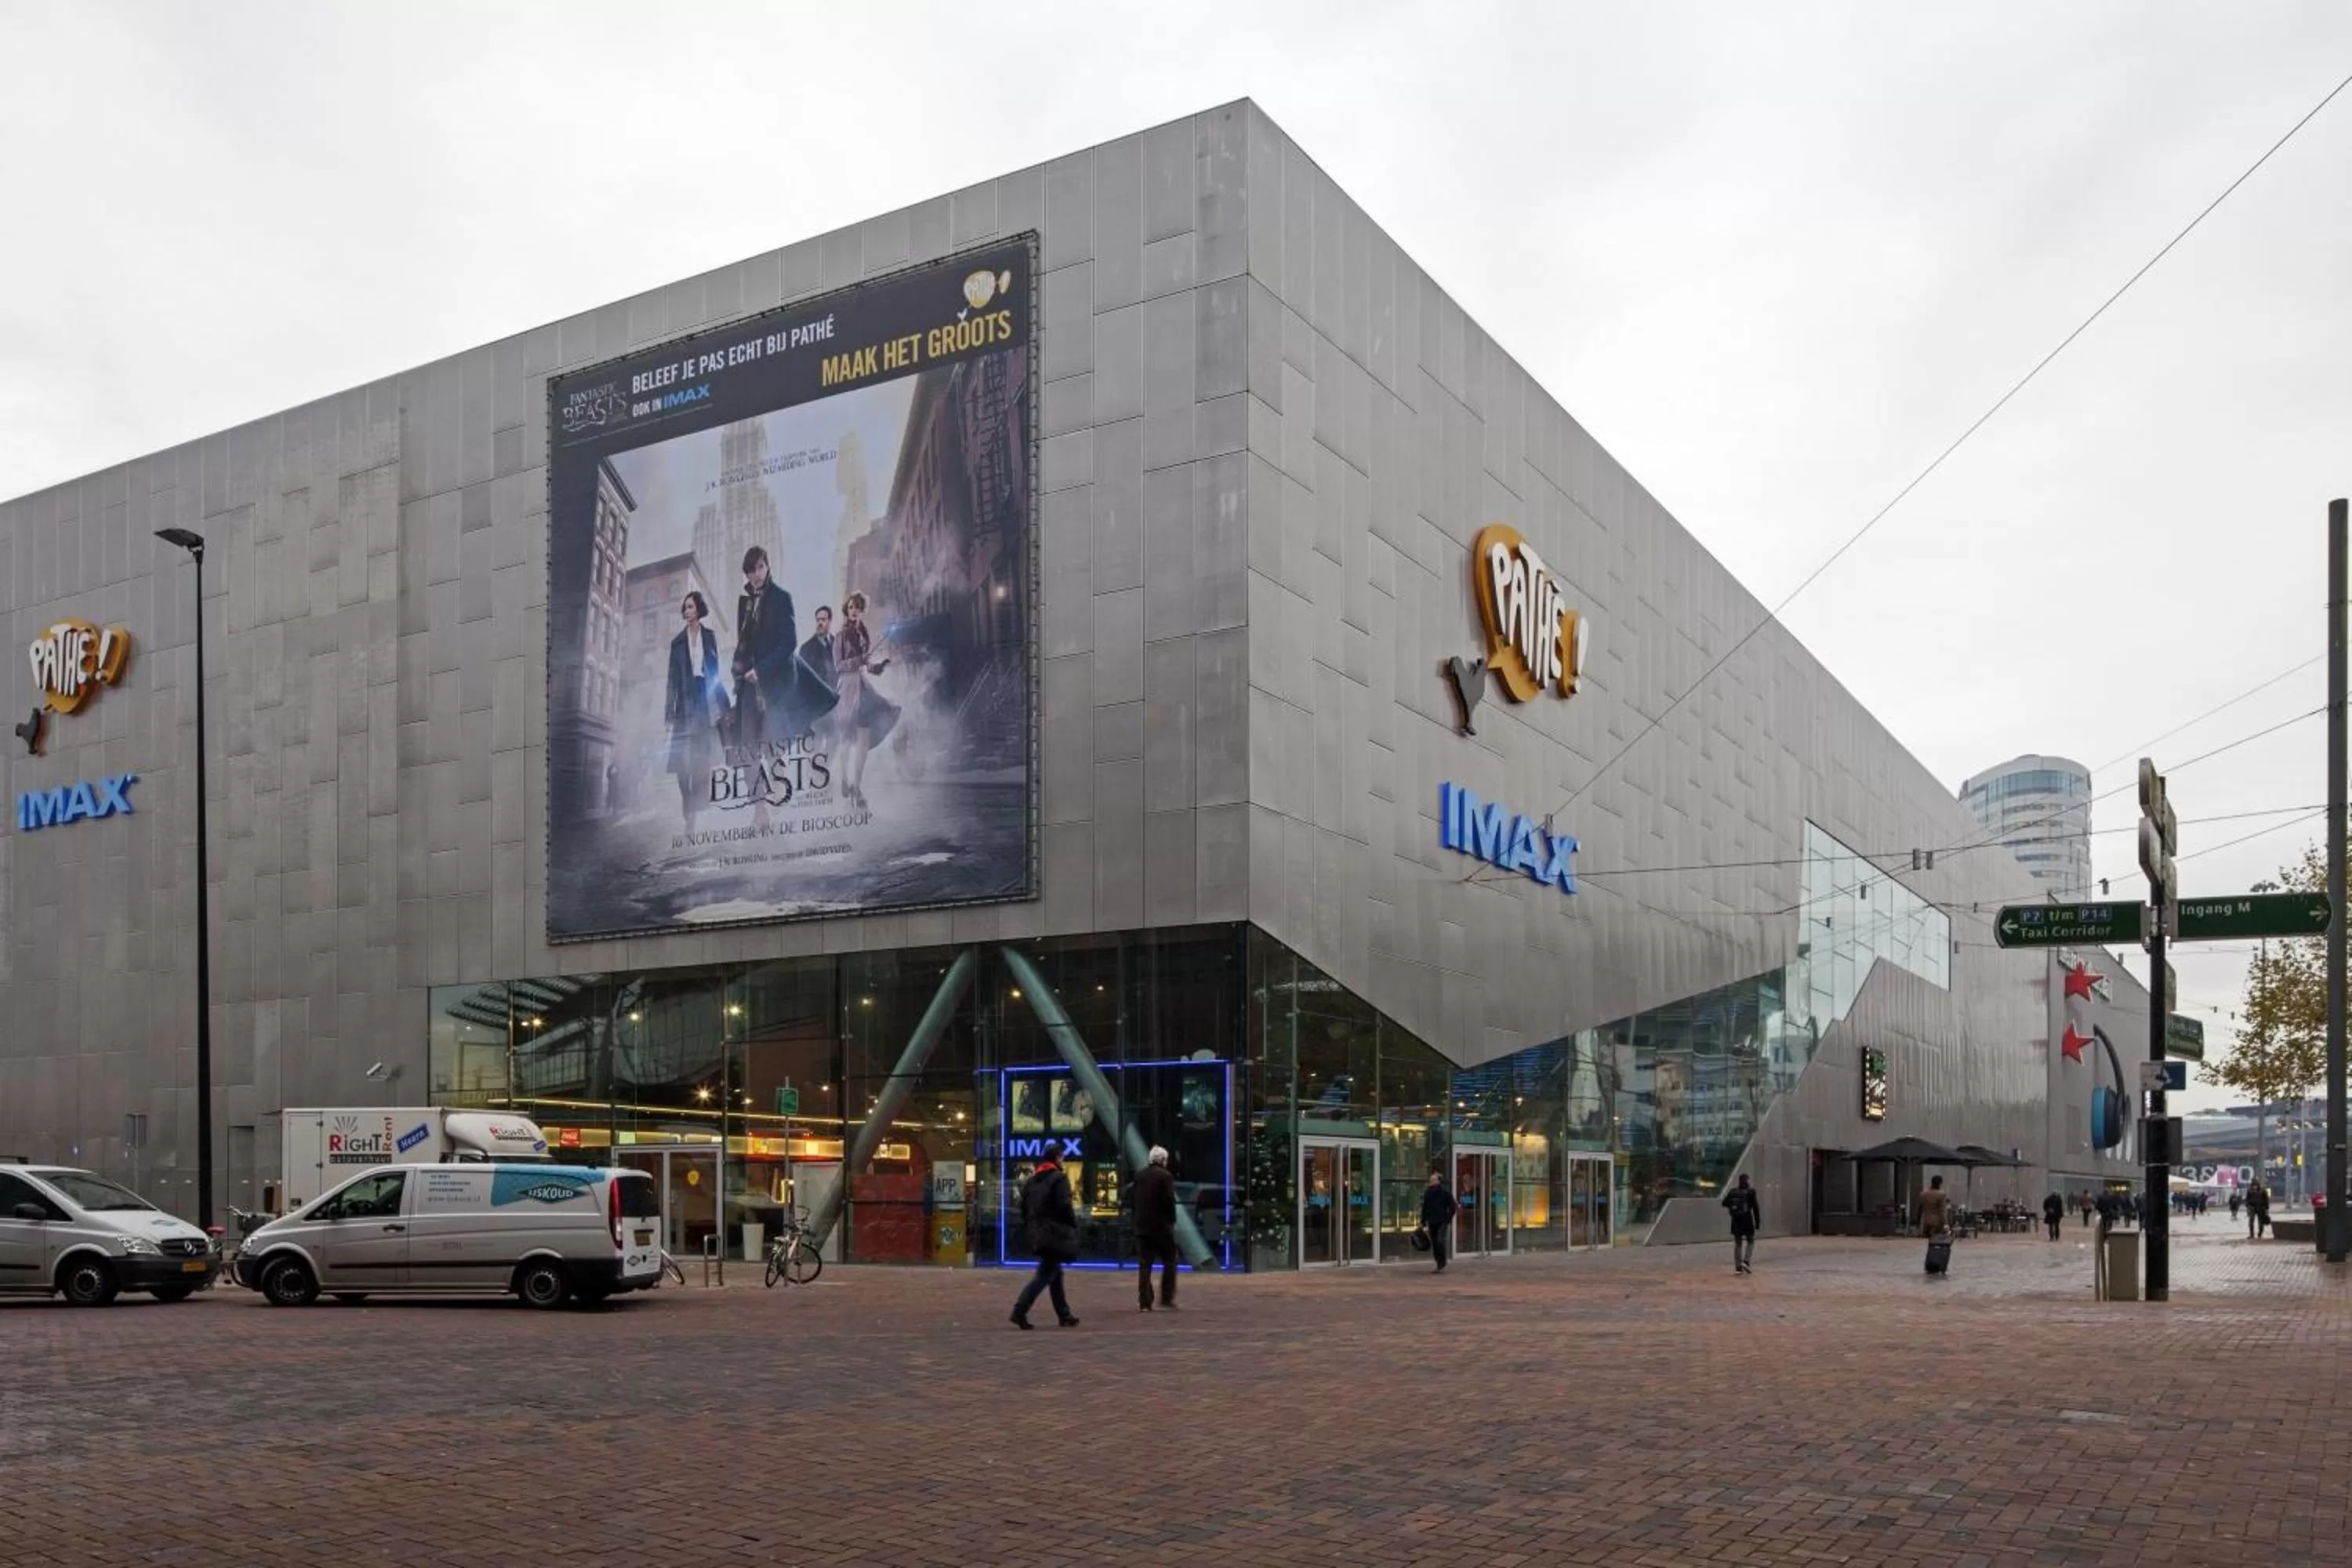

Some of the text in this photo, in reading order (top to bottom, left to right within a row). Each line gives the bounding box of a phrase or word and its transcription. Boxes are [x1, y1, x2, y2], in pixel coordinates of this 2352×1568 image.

[633, 313, 835, 394] BELEEF JE PAS ECHT BIJ PATHÉ
[822, 310, 1011, 387] MAAK HET GROOTS
[633, 383, 711, 418] OOK IN IMAX
[725, 732, 816, 764] FANTASTIC
[709, 753, 831, 809] BEASTS
[17, 773, 136, 830] IMAX
[688, 826, 756, 847] NOVEMBER
[780, 822, 798, 836] DE
[802, 812, 874, 833] BIOSCOOP
[1440, 781, 1581, 896] IMAX
[2049, 909, 2074, 922] t/m
[2081, 908, 2108, 920] P14
[2181, 902, 2251, 918] Ingang M
[2020, 925, 2112, 938] Taxi Corridor
[936, 1178, 956, 1192] APP
